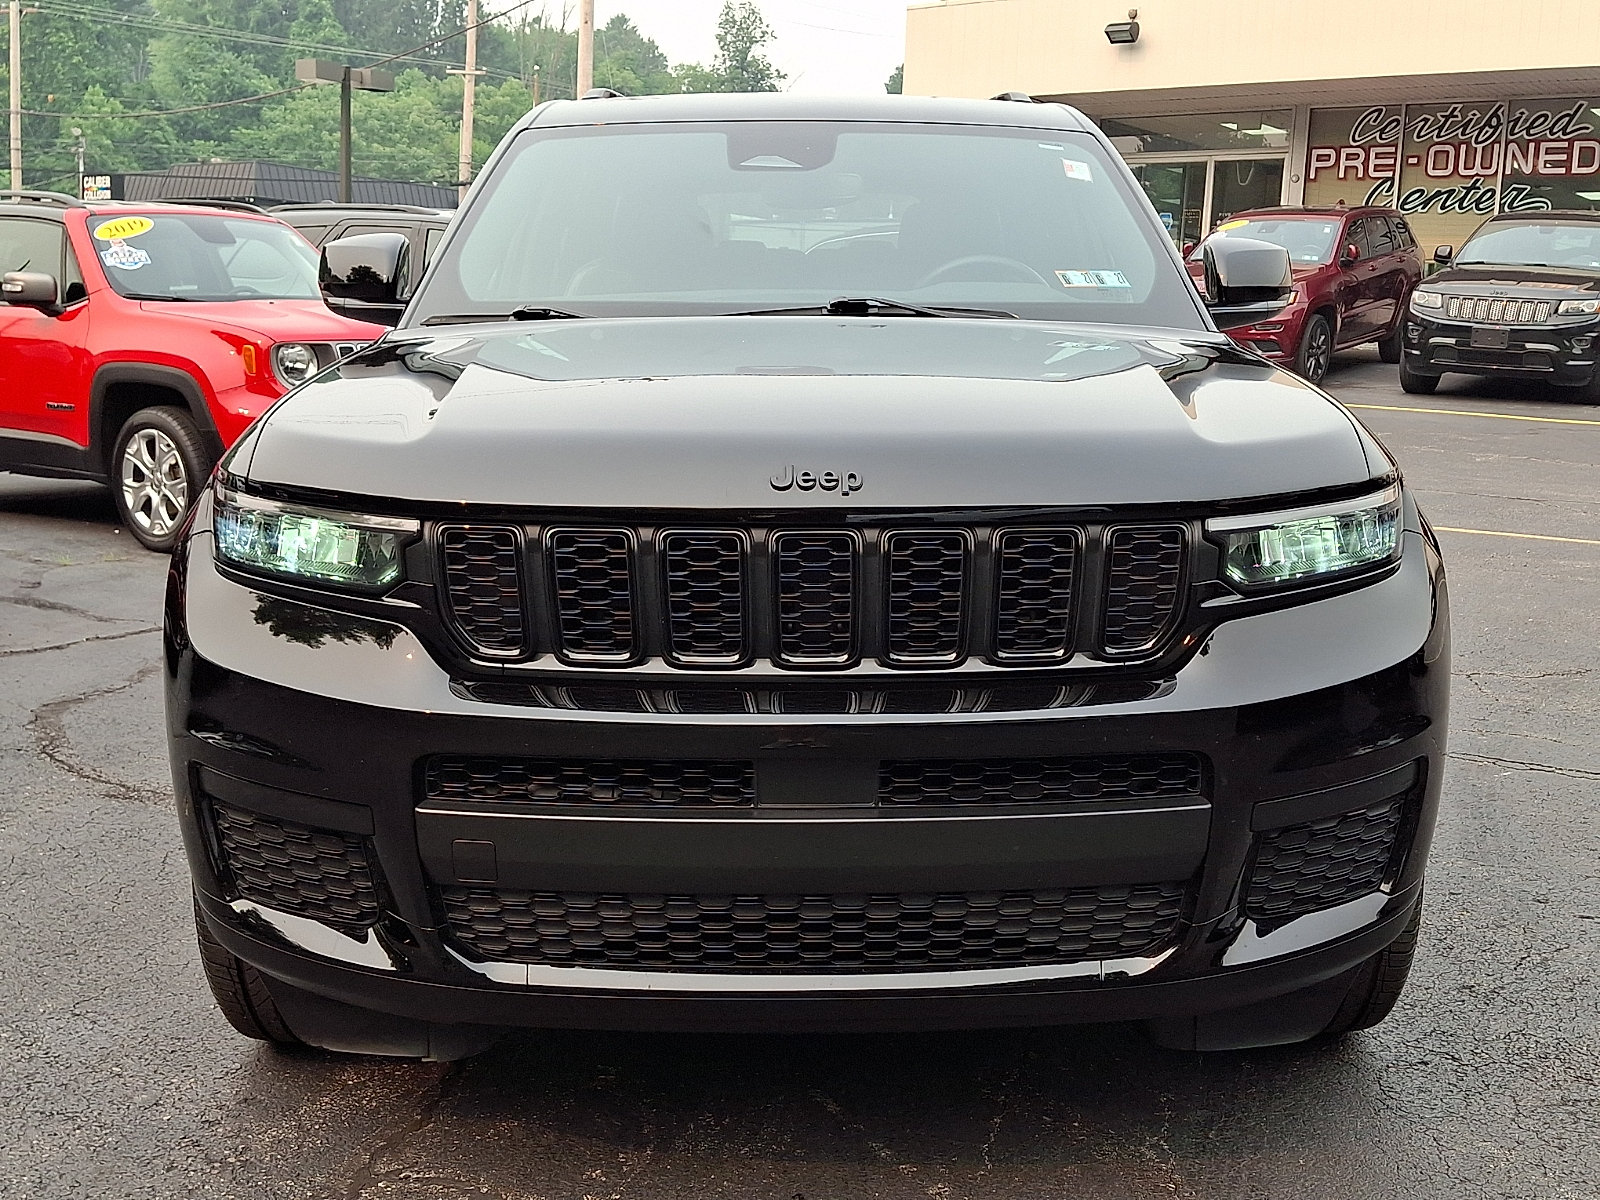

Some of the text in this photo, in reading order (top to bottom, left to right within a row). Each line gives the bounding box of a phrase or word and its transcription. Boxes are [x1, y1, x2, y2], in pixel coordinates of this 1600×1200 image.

[1349, 101, 1594, 146] Certified
[1308, 141, 1600, 179] PRE-OWNED
[84, 175, 111, 187] CALIBER
[1363, 177, 1552, 215] Center
[104, 220, 144, 238] 2019
[769, 464, 864, 496] Jeep
